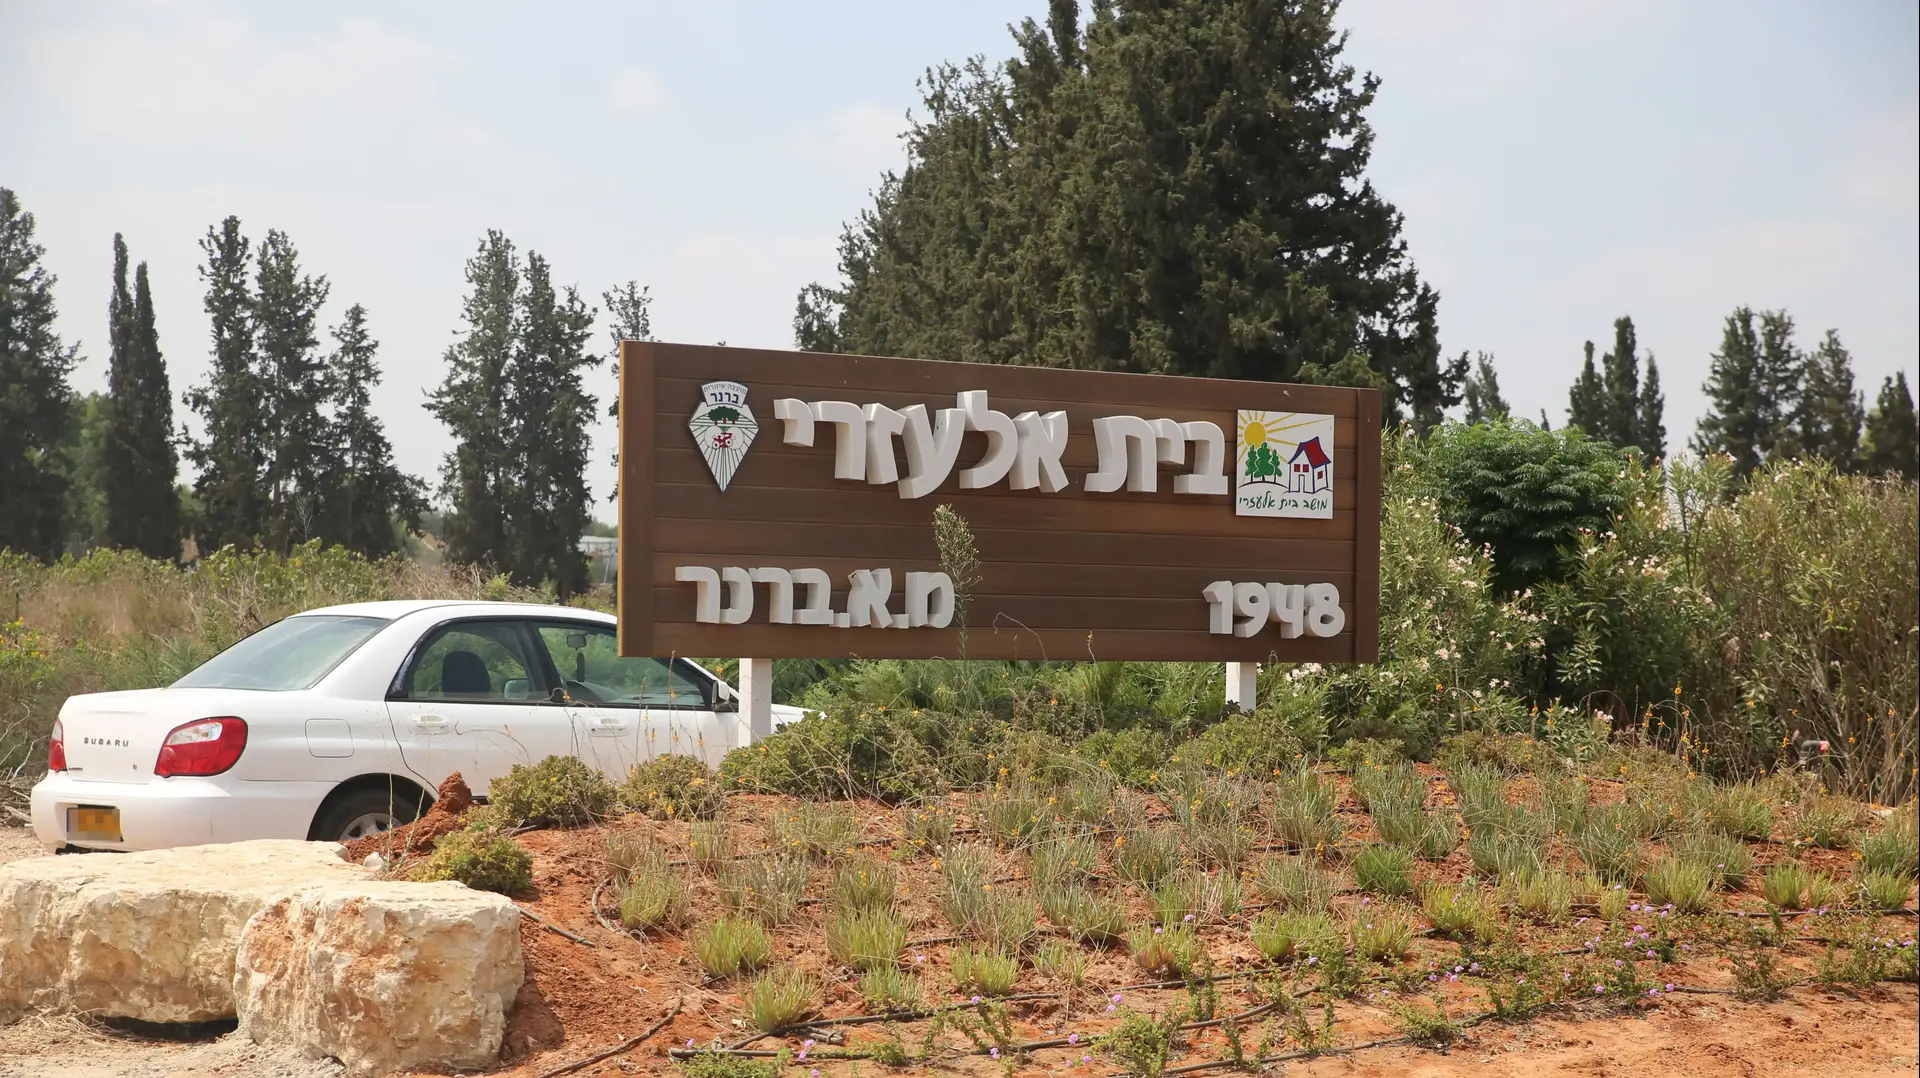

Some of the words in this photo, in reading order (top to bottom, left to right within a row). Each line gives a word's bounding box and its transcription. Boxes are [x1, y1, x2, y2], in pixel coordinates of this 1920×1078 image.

[710, 392, 739, 404] ברנר
[774, 390, 1069, 499] אלעזרי
[1084, 415, 1228, 494] בית
[1239, 490, 1275, 509] אלעזרי
[1278, 498, 1299, 511] בית
[1303, 498, 1328, 511] מושב
[1202, 580, 1346, 639] 1948
[84, 737, 129, 747] SUBARU
